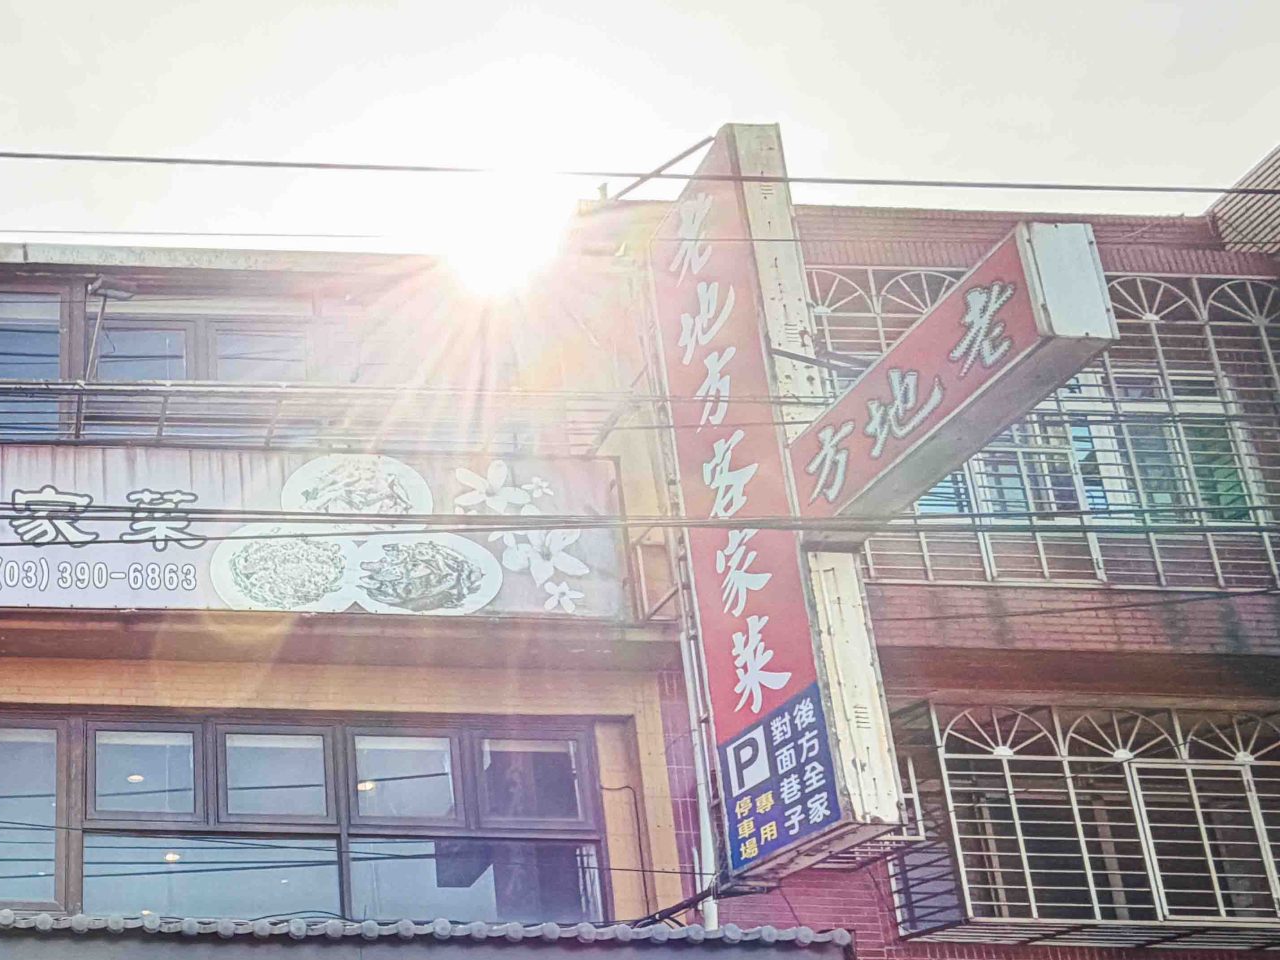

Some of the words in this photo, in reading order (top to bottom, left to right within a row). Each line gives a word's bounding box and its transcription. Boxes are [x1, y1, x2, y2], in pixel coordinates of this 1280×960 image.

[671, 192, 792, 715] 老地方客家菜
[806, 280, 1016, 506] 老地方
[732, 736, 762, 794] P
[754, 790, 779, 845] 專用
[770, 712, 806, 835] 對面巷子
[793, 697, 832, 824] 後方全家
[734, 796, 759, 860] 停車場
